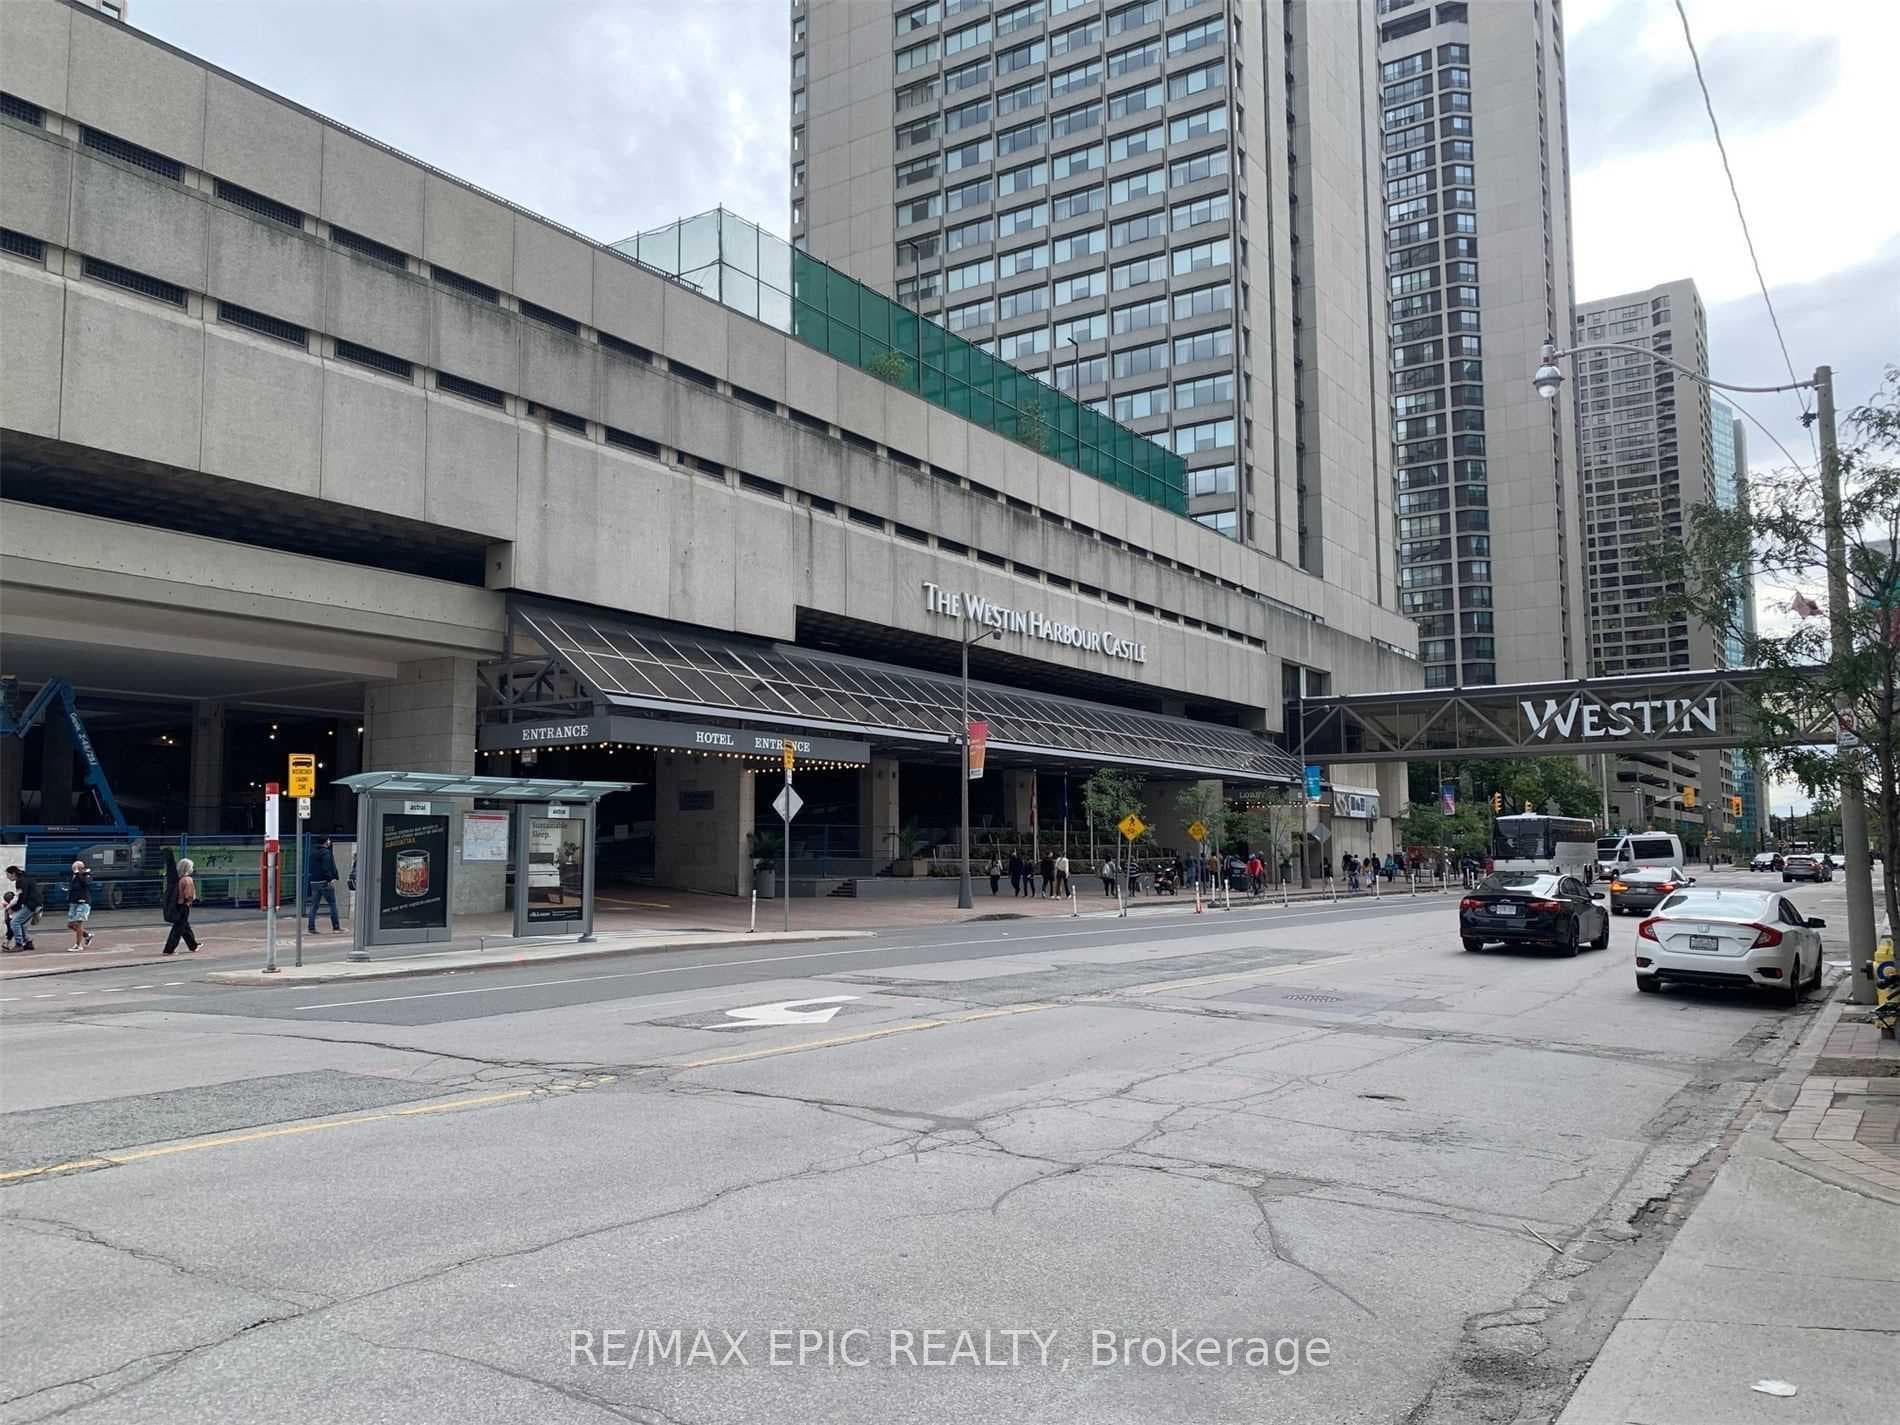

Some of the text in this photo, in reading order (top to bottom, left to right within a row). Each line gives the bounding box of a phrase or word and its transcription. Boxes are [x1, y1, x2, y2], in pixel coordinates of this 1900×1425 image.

[522, 724, 589, 740] ENTRANCE
[696, 731, 811, 753] HOTEL ENTRNCE
